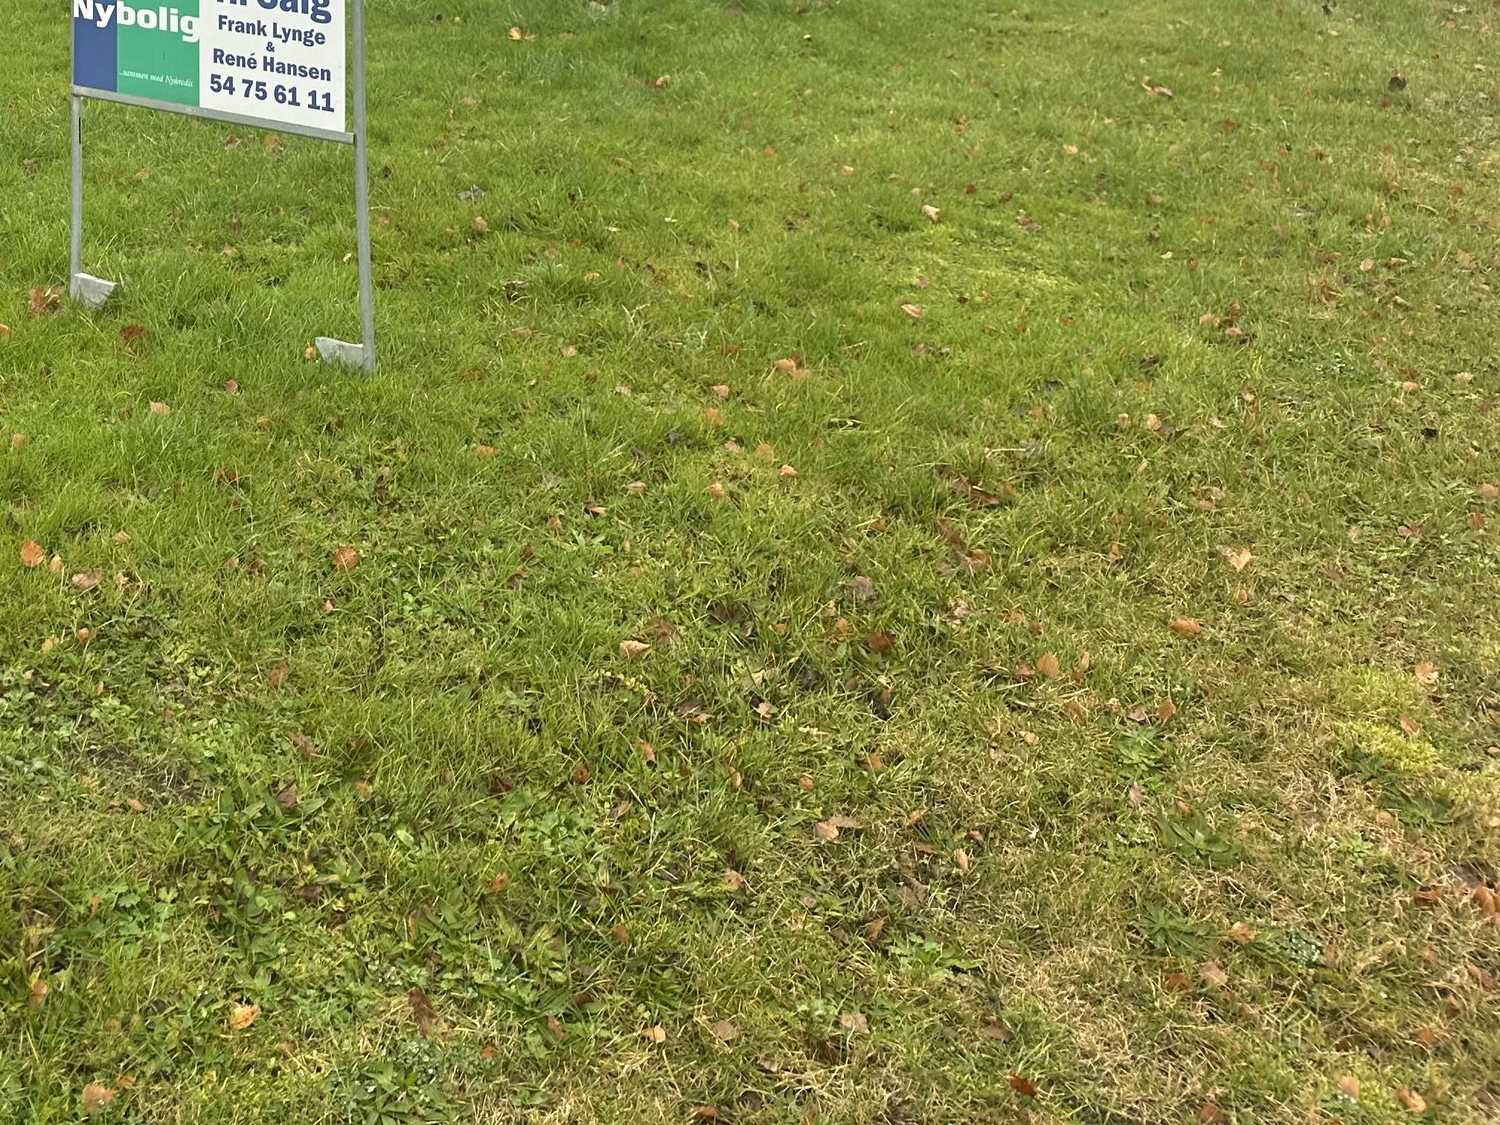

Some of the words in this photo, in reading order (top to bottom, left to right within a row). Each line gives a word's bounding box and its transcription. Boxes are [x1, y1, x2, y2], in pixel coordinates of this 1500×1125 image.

[218, 14, 267, 37] Frank
[272, 22, 325, 47] Lynge
[266, 41, 275, 53] &
[213, 47, 257, 70] René
[263, 55, 331, 82] Hansen
[210, 73, 236, 96] 54
[241, 78, 268, 101] 75
[273, 84, 300, 107] 61
[307, 89, 335, 113] 11
